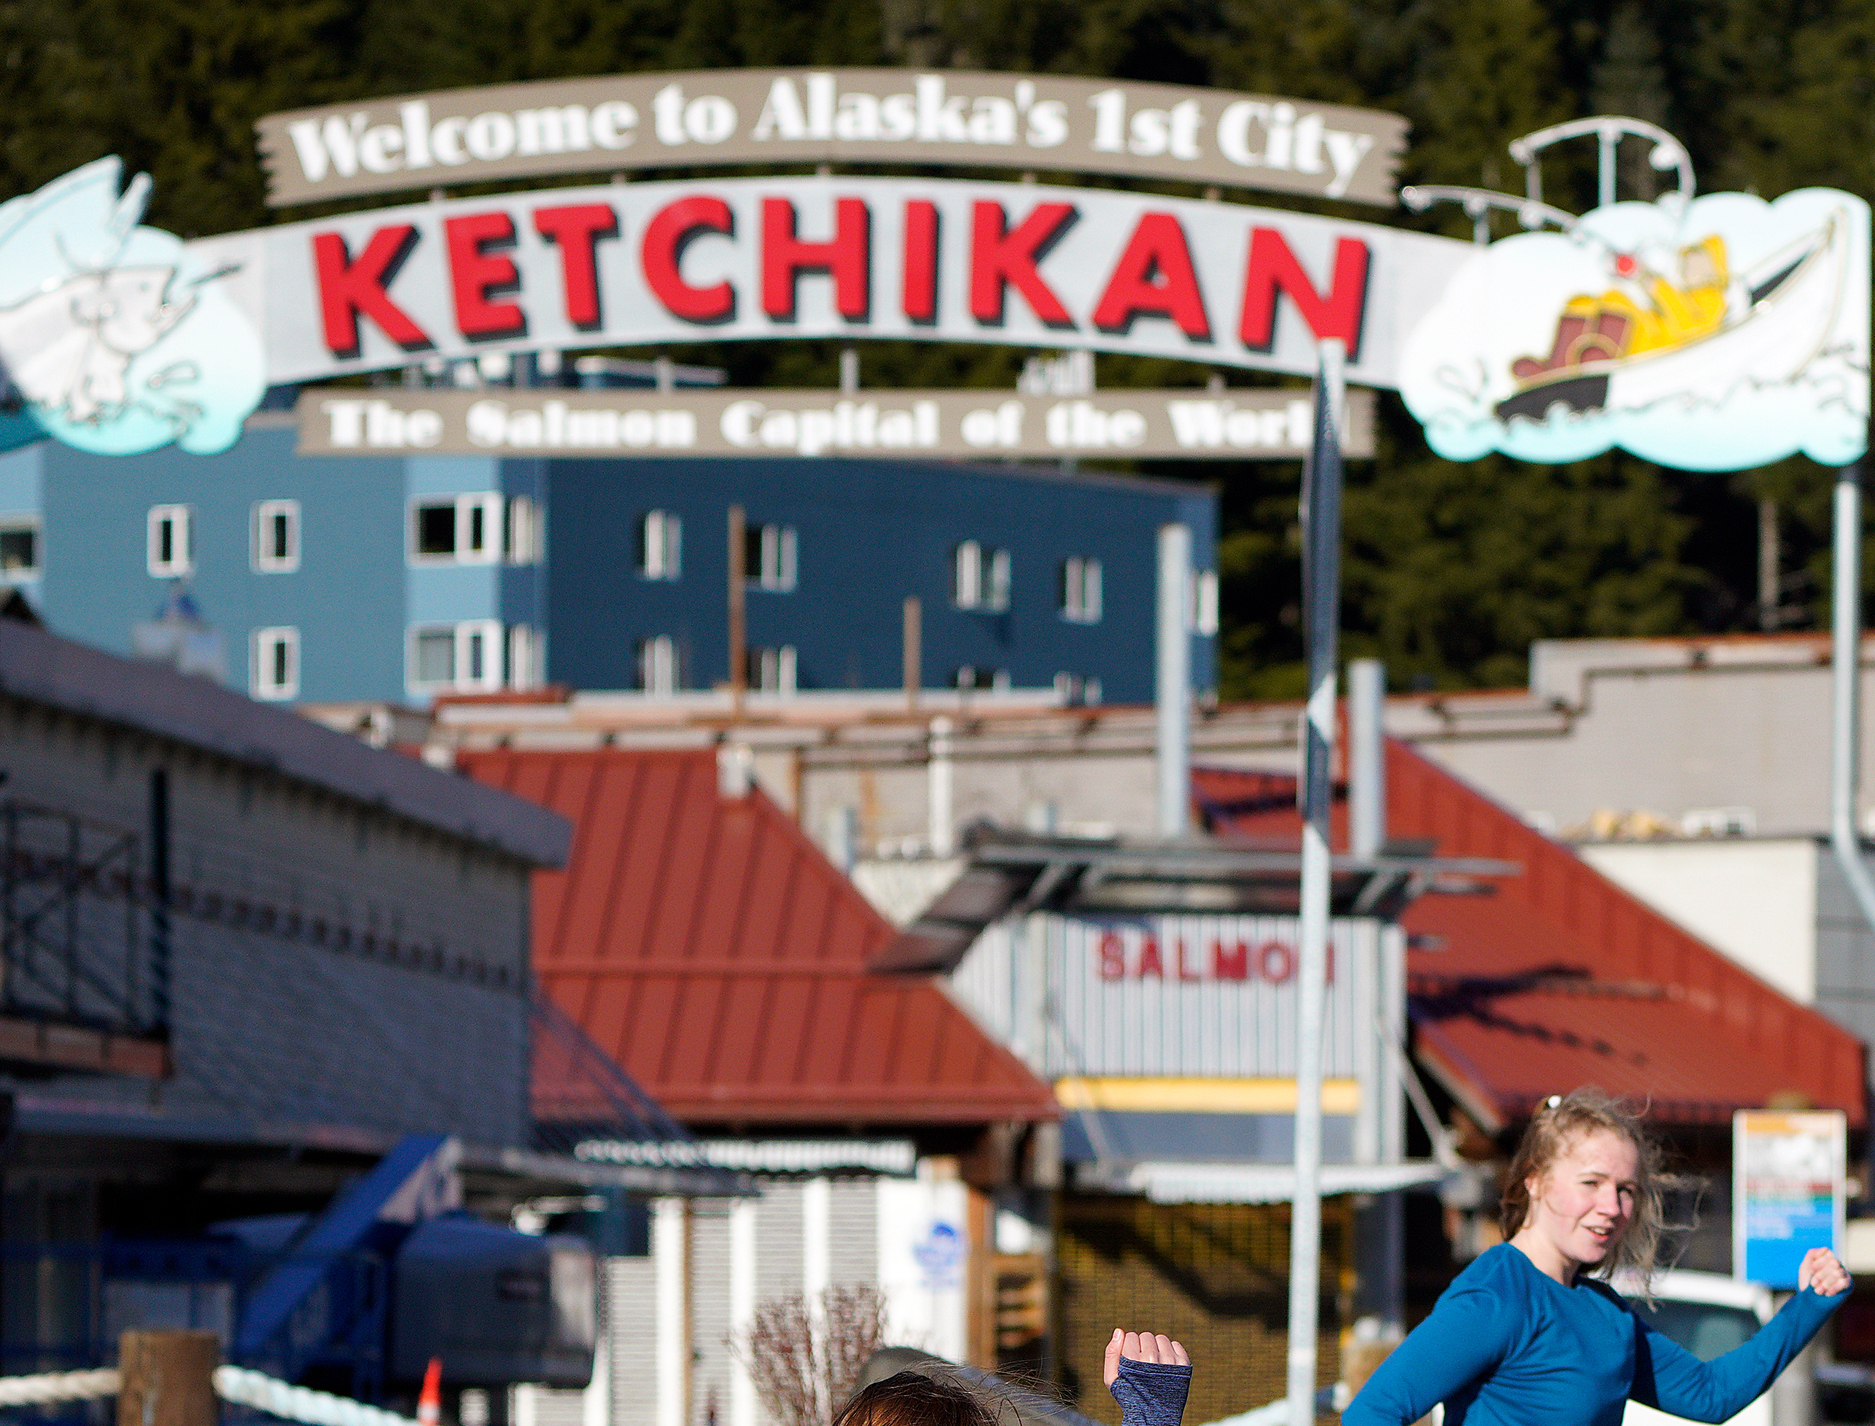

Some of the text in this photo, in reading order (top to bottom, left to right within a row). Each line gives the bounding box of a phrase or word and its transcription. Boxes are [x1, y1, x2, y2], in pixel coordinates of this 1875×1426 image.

[288, 72, 1377, 198] Welcome to Alaska's 1st City
[311, 195, 1372, 363] KETCHIKAN
[320, 400, 1350, 456] The Salmon Capital of the Worl
[1096, 929, 1335, 985] SALMO
